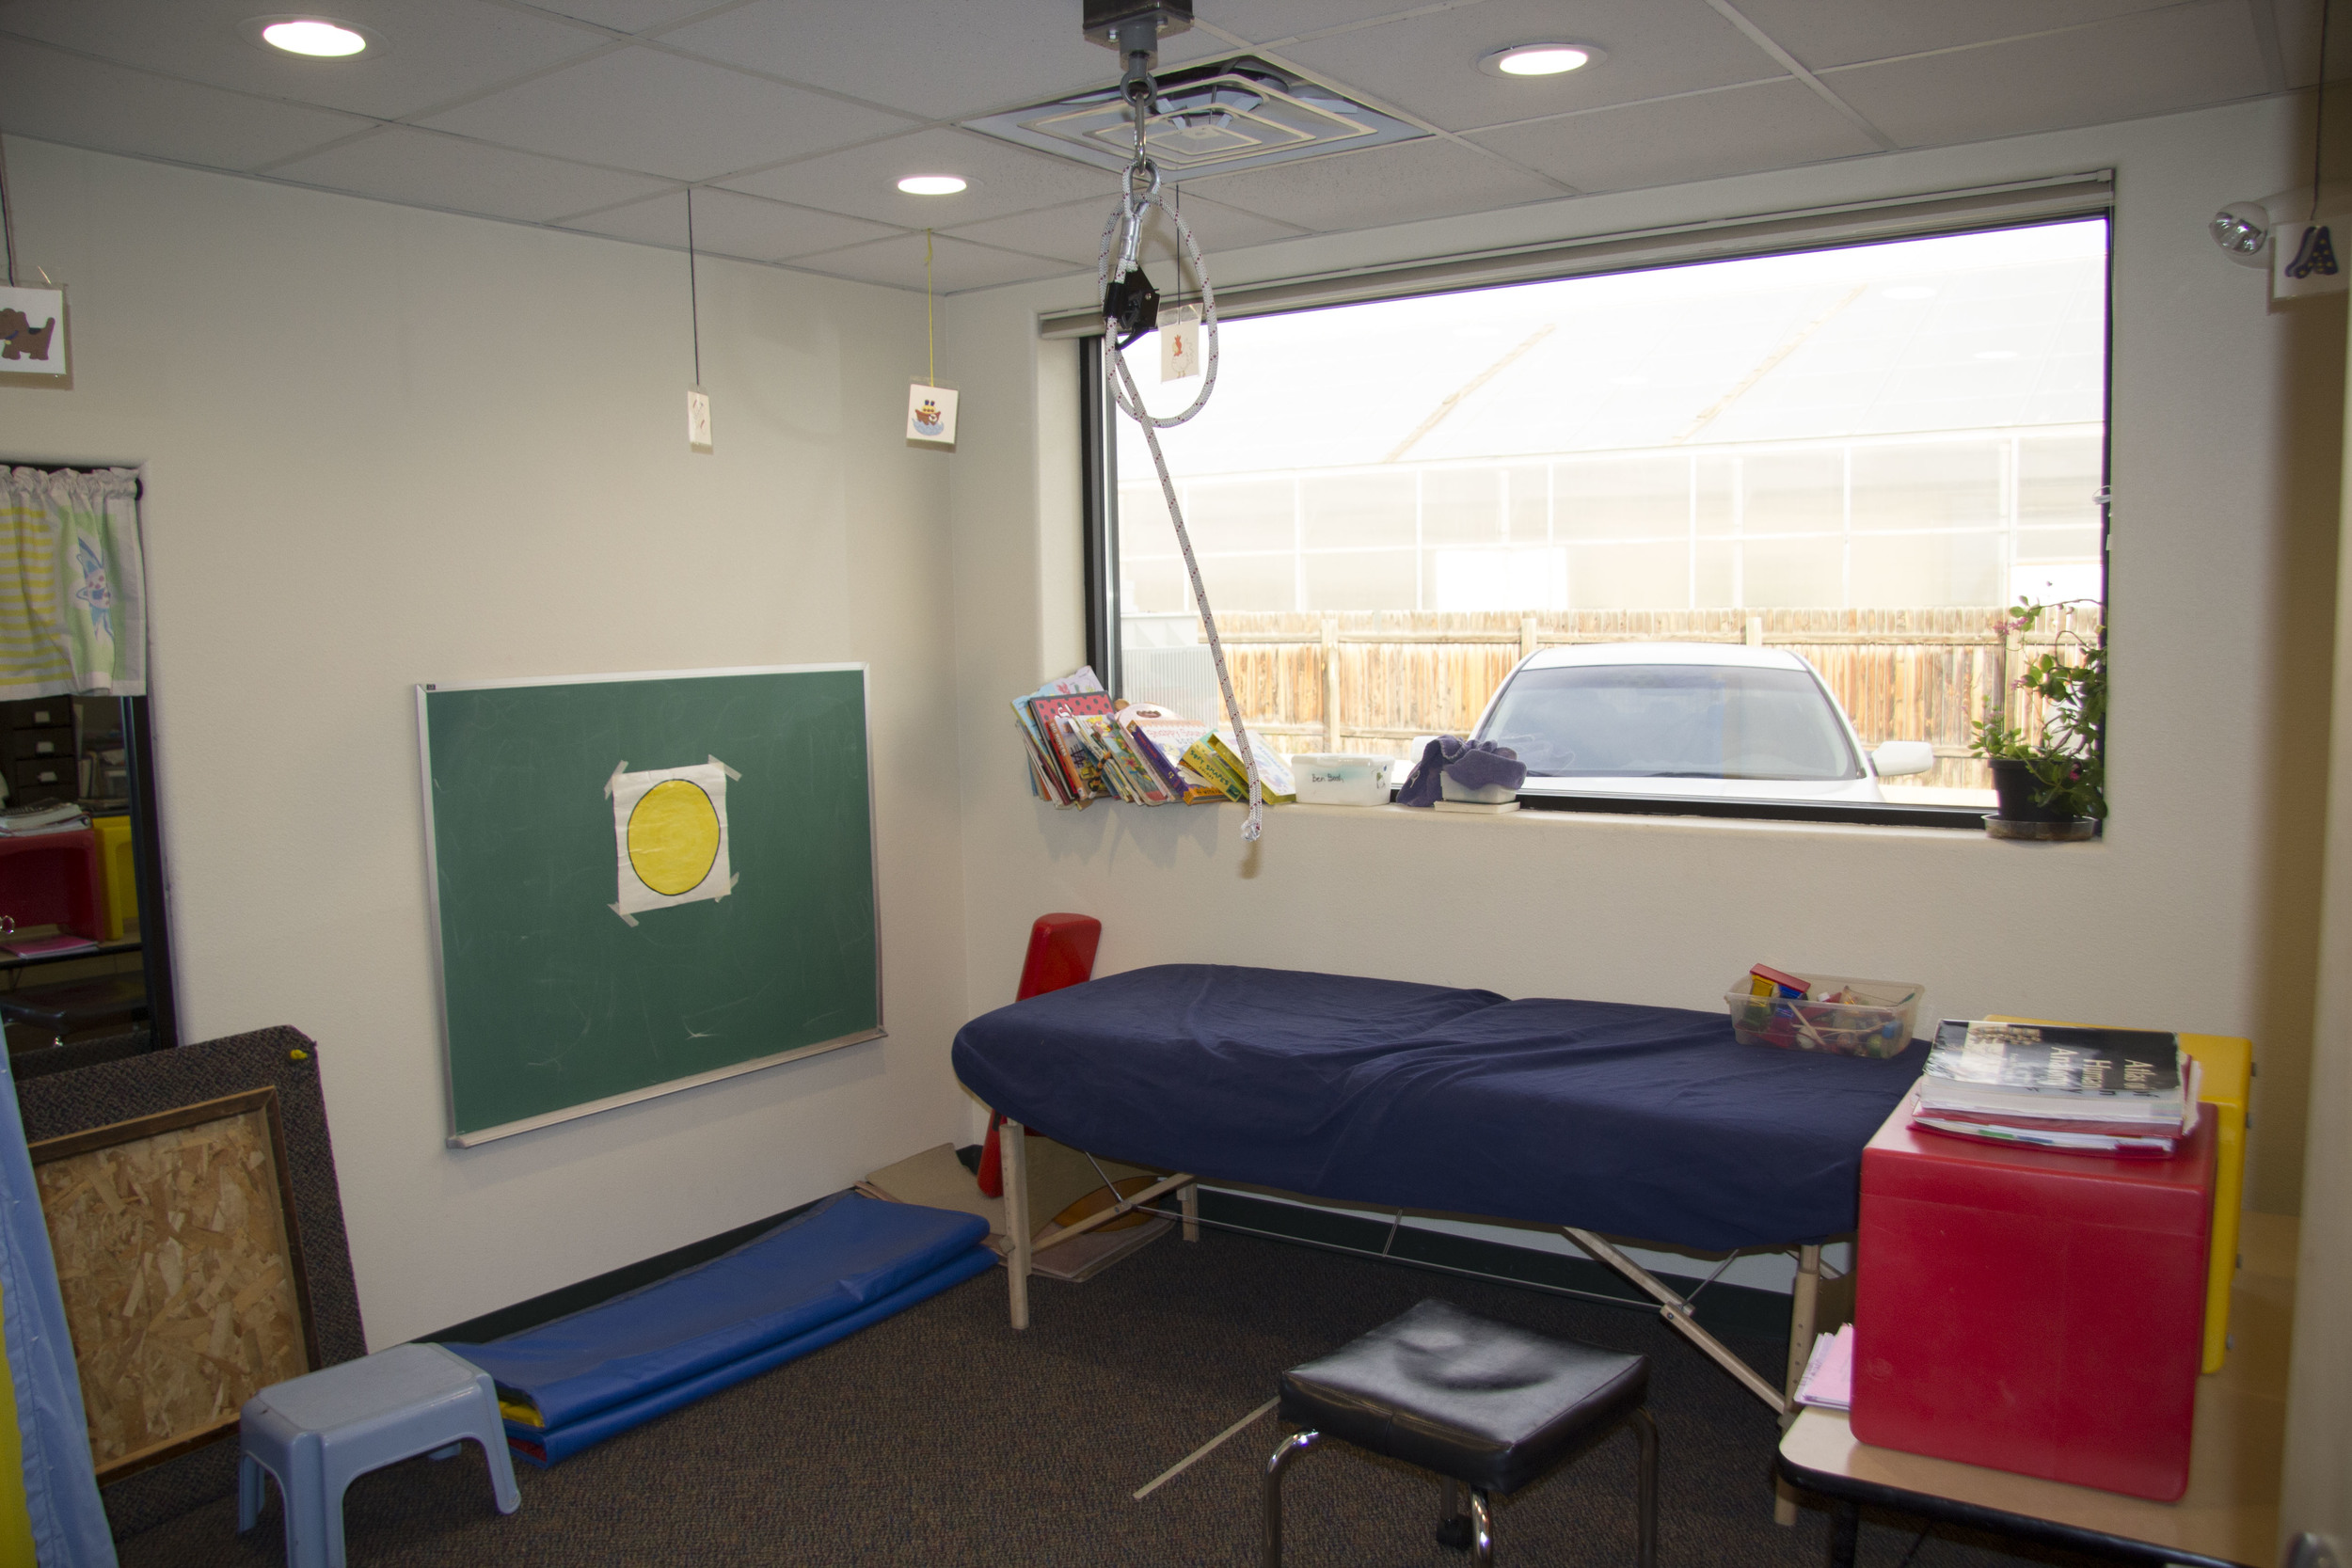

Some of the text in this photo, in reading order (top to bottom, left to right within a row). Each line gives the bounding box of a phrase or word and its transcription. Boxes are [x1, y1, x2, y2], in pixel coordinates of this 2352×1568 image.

[1049, 722, 1068, 757] BIG MOVERS
[1190, 749, 1205, 765] SOFT
[1205, 764, 1230, 786] SHAPES
[2039, 1046, 2079, 1087] Anatomy
[2083, 1058, 2117, 1089] Human
[2124, 1058, 2158, 1084] Atlas
